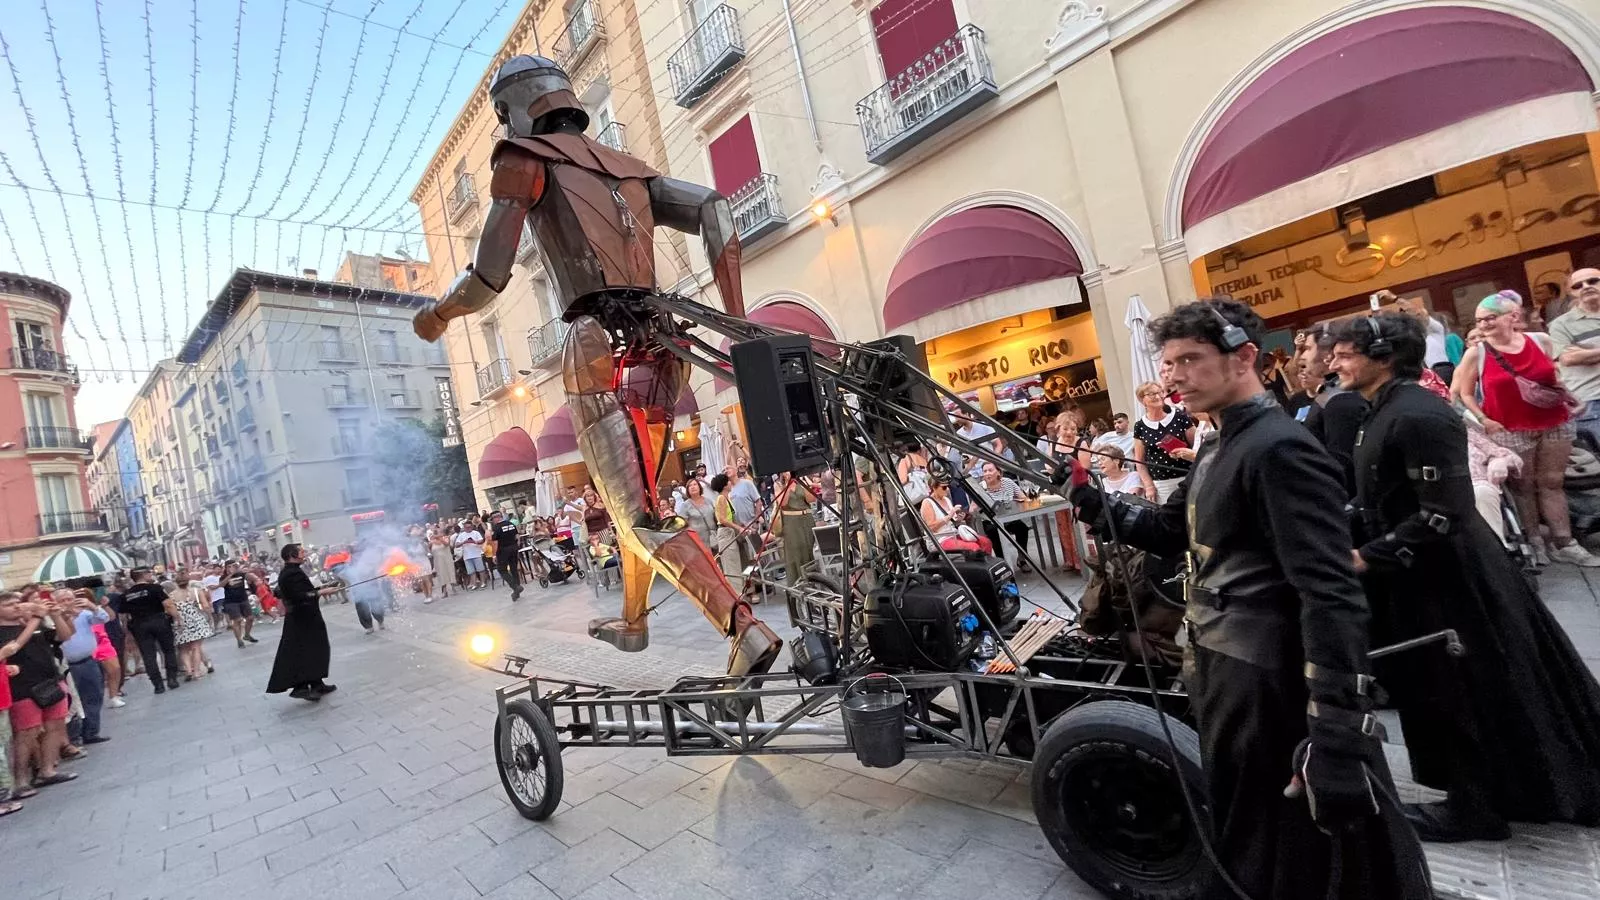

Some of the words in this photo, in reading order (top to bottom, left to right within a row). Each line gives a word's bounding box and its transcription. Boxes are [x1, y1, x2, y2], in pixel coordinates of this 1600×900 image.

[947, 356, 1009, 388] PUERTO
[1028, 339, 1068, 366] RICO
[439, 382, 456, 435] HOSTAL
